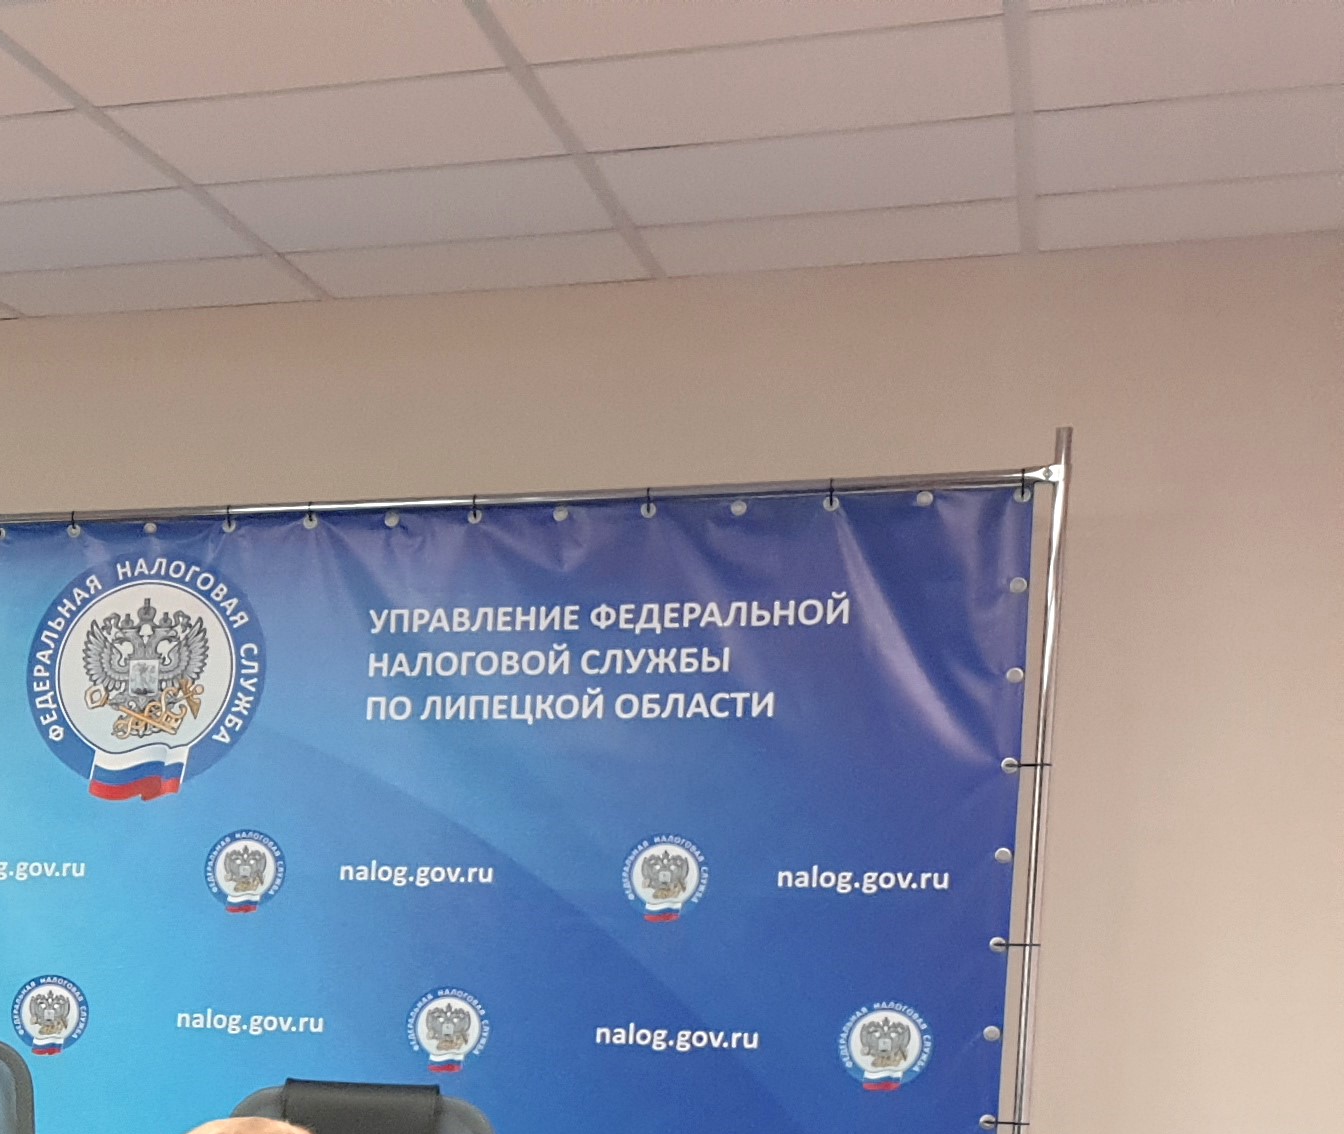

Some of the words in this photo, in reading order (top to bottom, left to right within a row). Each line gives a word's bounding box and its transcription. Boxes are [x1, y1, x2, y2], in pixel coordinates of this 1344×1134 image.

[369, 605, 580, 634] УПРАВЛЕНИЕ
[590, 591, 850, 635] ФЕДЕРАЛЬНОЙ
[33, 575, 102, 741] ФЕДЕРАЛЬНАЯ
[116, 558, 250, 628] НАЛОГОВАЯ
[212, 643, 258, 744] СЛУЖБА
[368, 643, 570, 678] НАЛОГОВОЙ
[580, 646, 730, 675] СЛУЖБЫ
[366, 696, 412, 721] ПО
[420, 687, 604, 725] ЛИПЕЦКОЙ
[614, 691, 774, 719] ОБЛАСТИ
[340, 859, 493, 887] nalog.gov.ru
[777, 864, 949, 894] nalog.gov.ru
[177, 1008, 324, 1036] nalog.gov.ru
[595, 1022, 759, 1052] nalog.gov.ru
